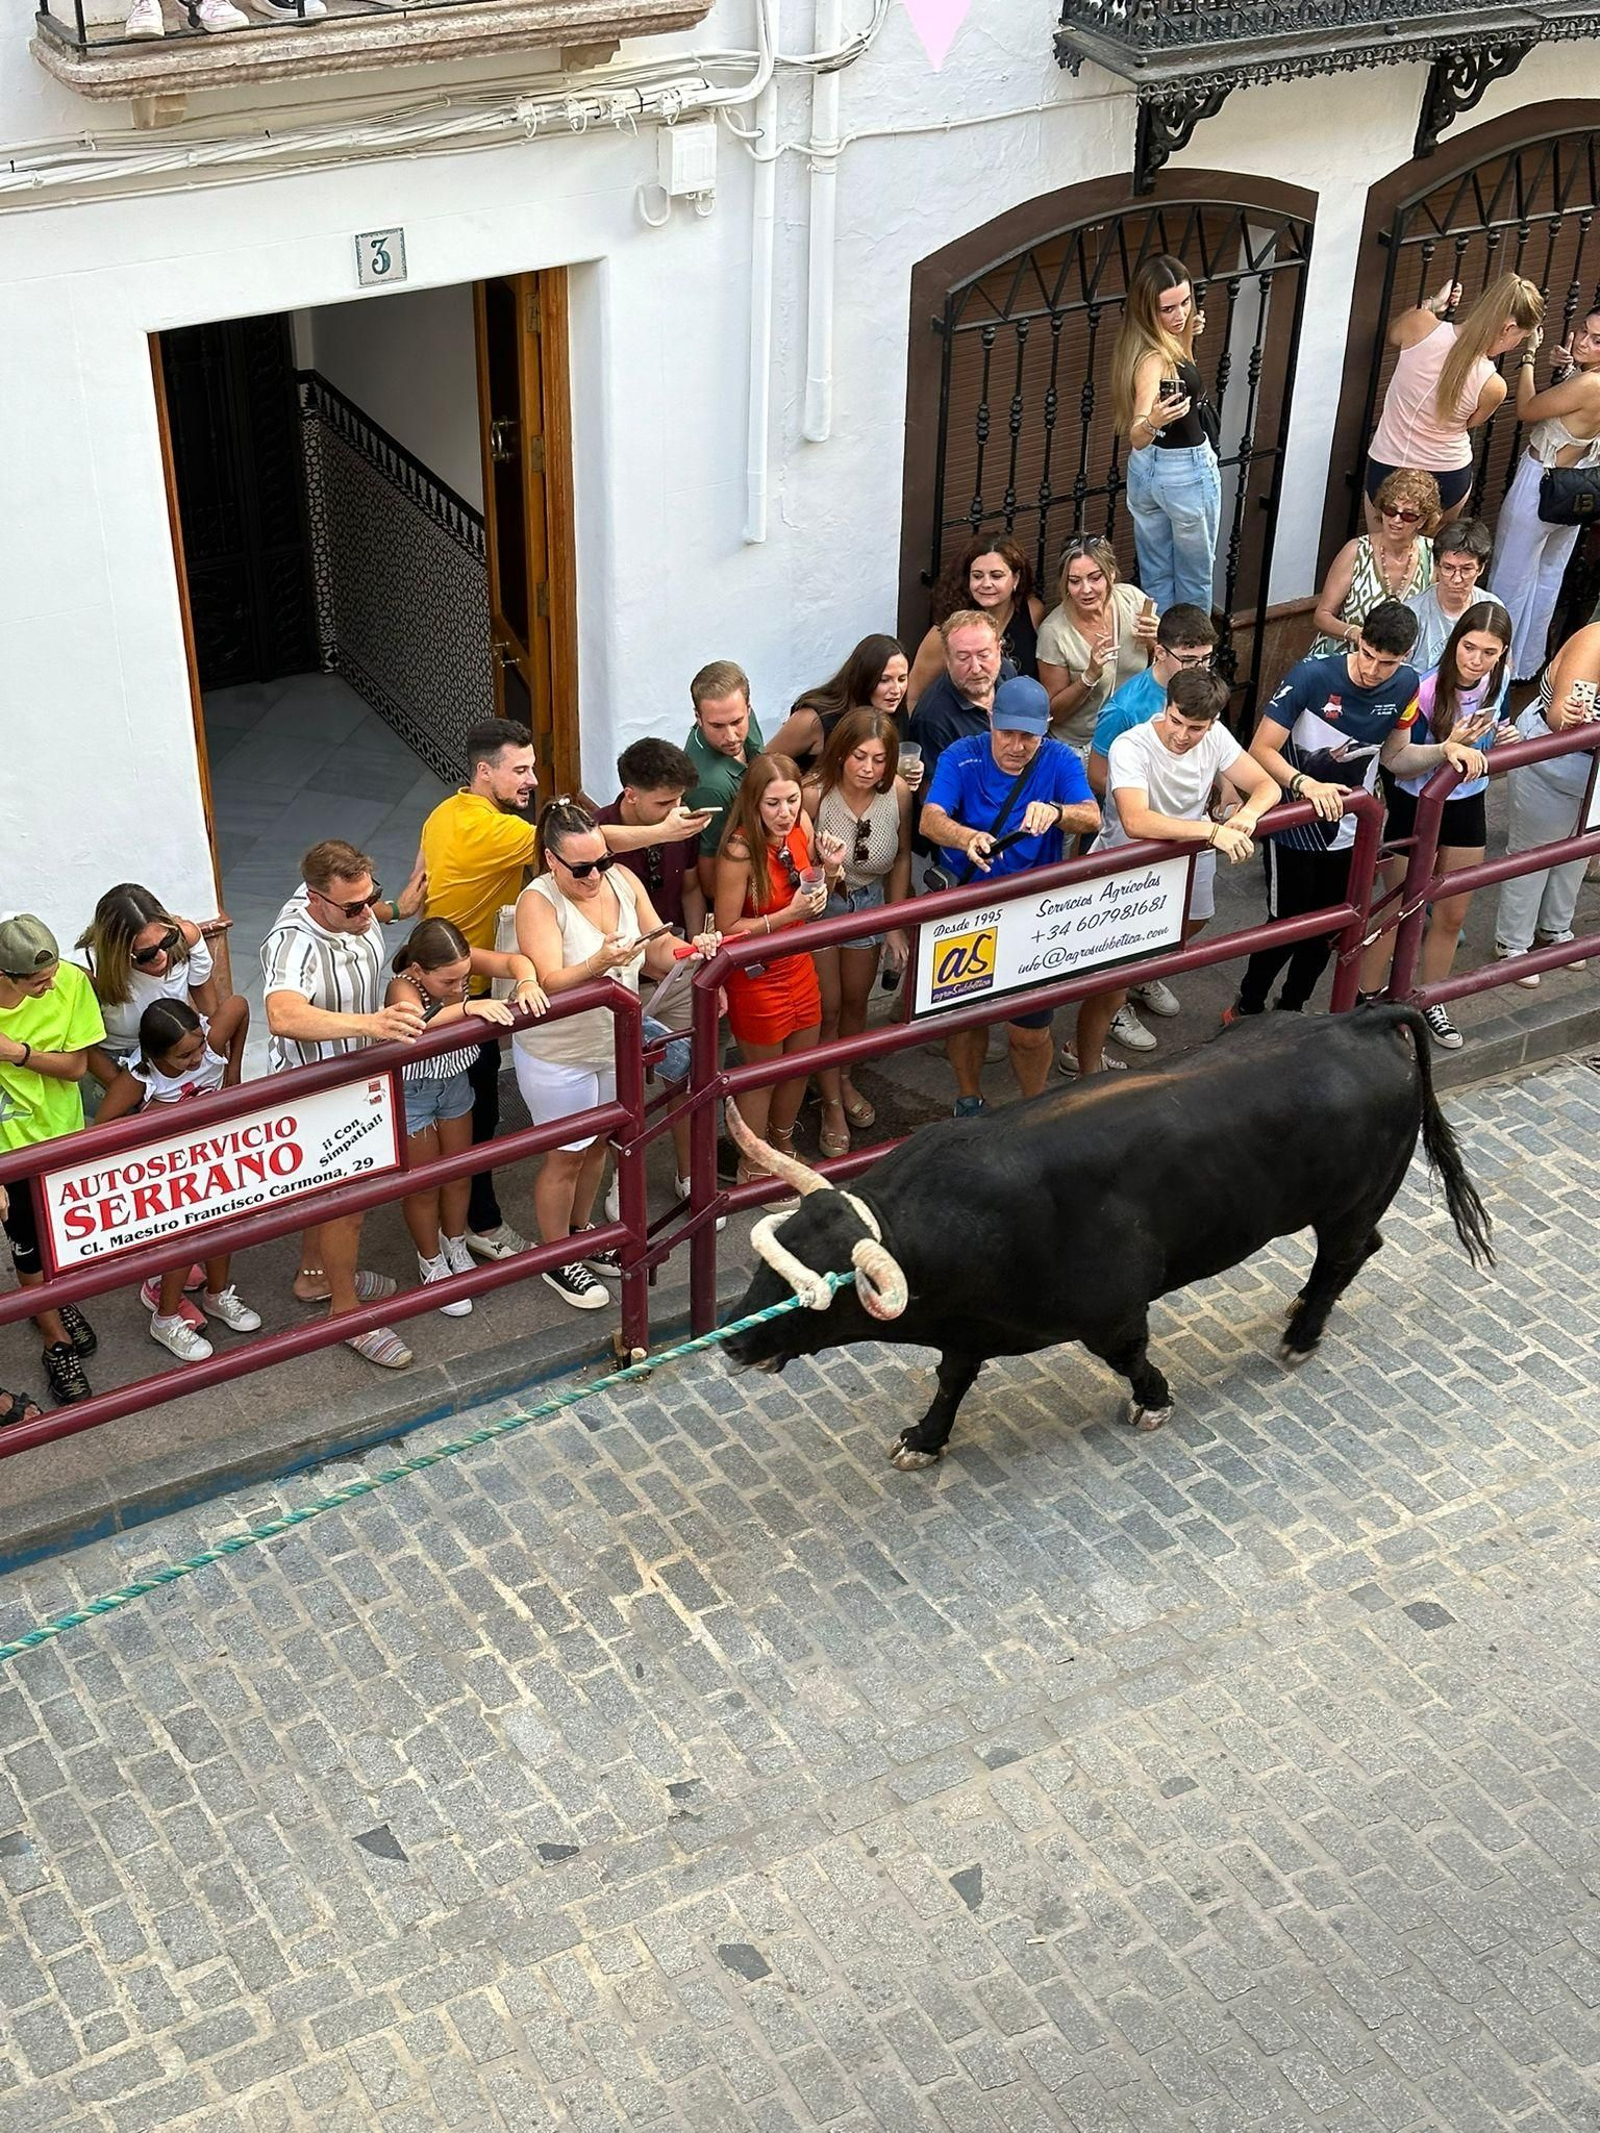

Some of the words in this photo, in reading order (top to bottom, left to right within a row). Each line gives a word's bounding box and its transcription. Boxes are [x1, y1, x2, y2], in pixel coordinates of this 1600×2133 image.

[370, 236, 391, 275] 3
[933, 918, 970, 938] Desde
[974, 909, 1003, 927] 1995
[1031, 921, 1072, 943] +34
[1076, 895, 1168, 932] 607981681
[1036, 894, 1093, 918] Servicios
[1017, 926, 1170, 975] info@agrosubbetica.com
[334, 1118, 360, 1140] Con
[59, 1116, 298, 1206] AUTOSERVICIO
[64, 1142, 304, 1242] SERRANO
[110, 1220, 179, 1248] Maestro
[184, 1193, 264, 1226] Francisco
[269, 1167, 348, 1198] Carmona,
[352, 1156, 374, 1172] 29
